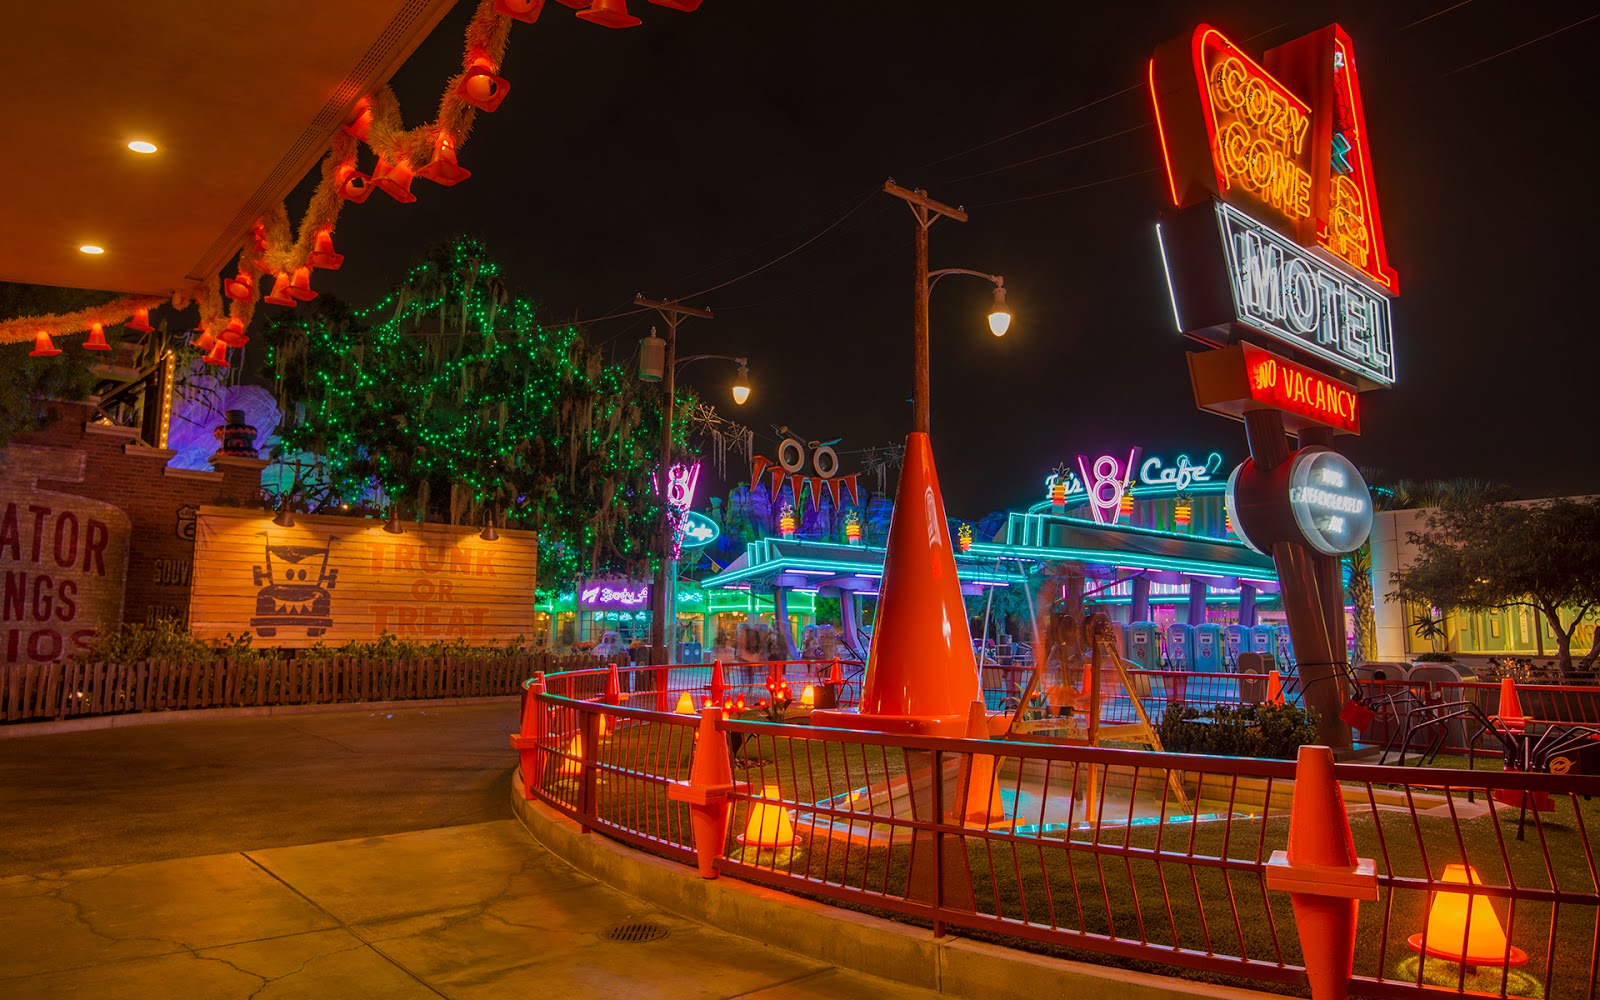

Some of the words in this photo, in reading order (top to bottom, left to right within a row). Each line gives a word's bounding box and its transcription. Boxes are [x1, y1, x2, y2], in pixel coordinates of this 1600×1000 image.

[1212, 56, 1309, 158] COZY
[1217, 121, 1312, 219] CONE
[1238, 228, 1391, 369] MOTEL
[1254, 359, 1277, 390] NO
[1282, 366, 1357, 422] VACANCY
[0, 502, 110, 577] ATOR
[365, 542, 498, 578] TRUNK
[3, 571, 78, 622] NGS
[368, 604, 491, 637] TREAT
[410, 578, 455, 601] OR
